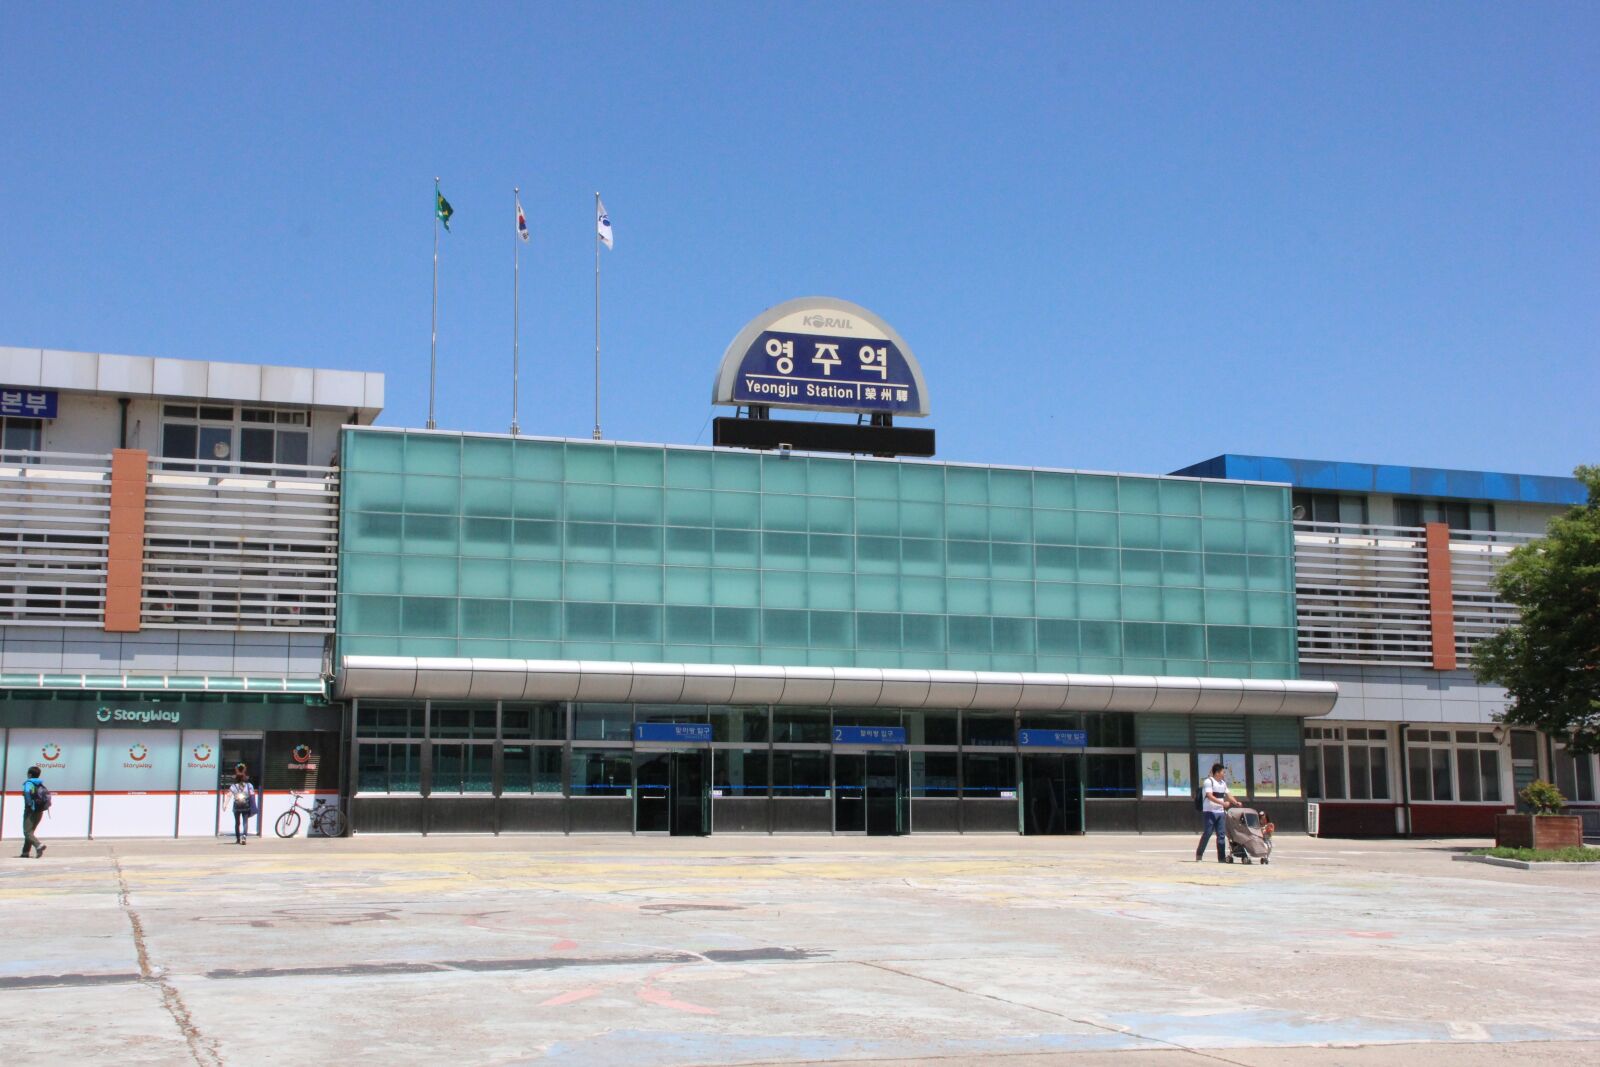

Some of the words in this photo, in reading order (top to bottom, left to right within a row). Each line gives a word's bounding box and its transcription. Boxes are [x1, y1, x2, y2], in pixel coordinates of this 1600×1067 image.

[803, 315, 852, 329] KORAIL
[765, 339, 887, 380] 영주역
[745, 379, 798, 398] Yeongju
[806, 383, 853, 399] Station
[0, 391, 47, 415] 본부
[638, 726, 643, 738] 1
[835, 729, 843, 741] 2
[1021, 732, 1029, 744] 3
